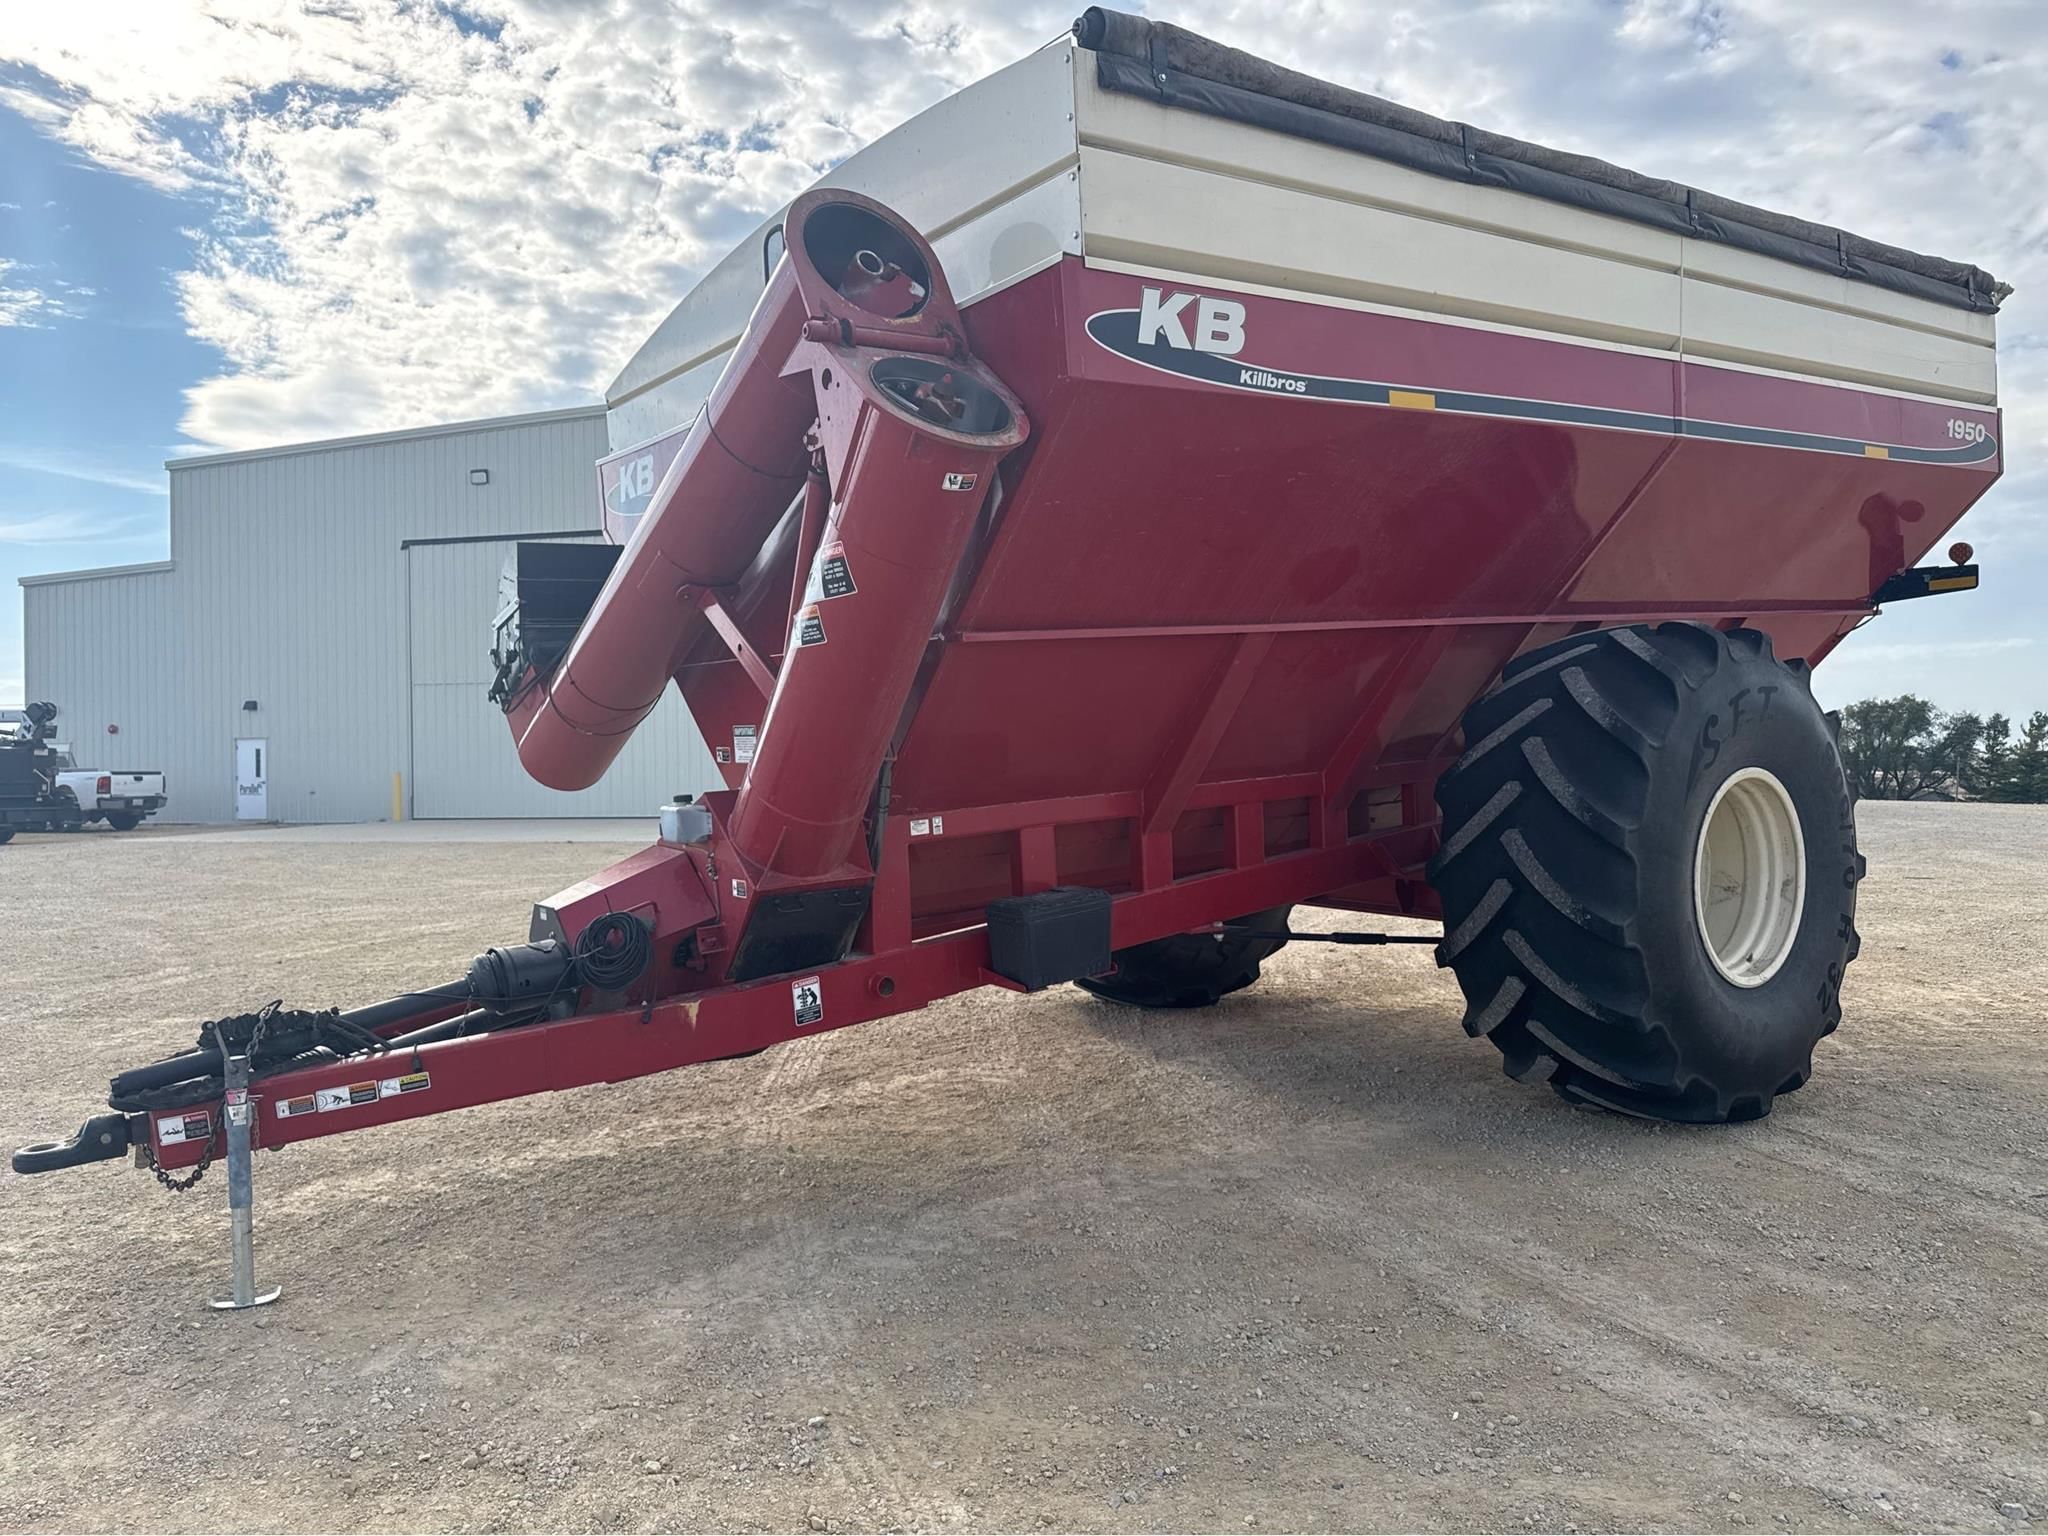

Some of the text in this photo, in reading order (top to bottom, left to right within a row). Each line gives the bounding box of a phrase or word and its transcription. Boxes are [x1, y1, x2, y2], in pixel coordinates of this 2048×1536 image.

[1138, 286, 1246, 355] KB
[1240, 370, 1306, 392] Killbros
[1947, 418, 1985, 443] 1950
[619, 454, 654, 503] KB
